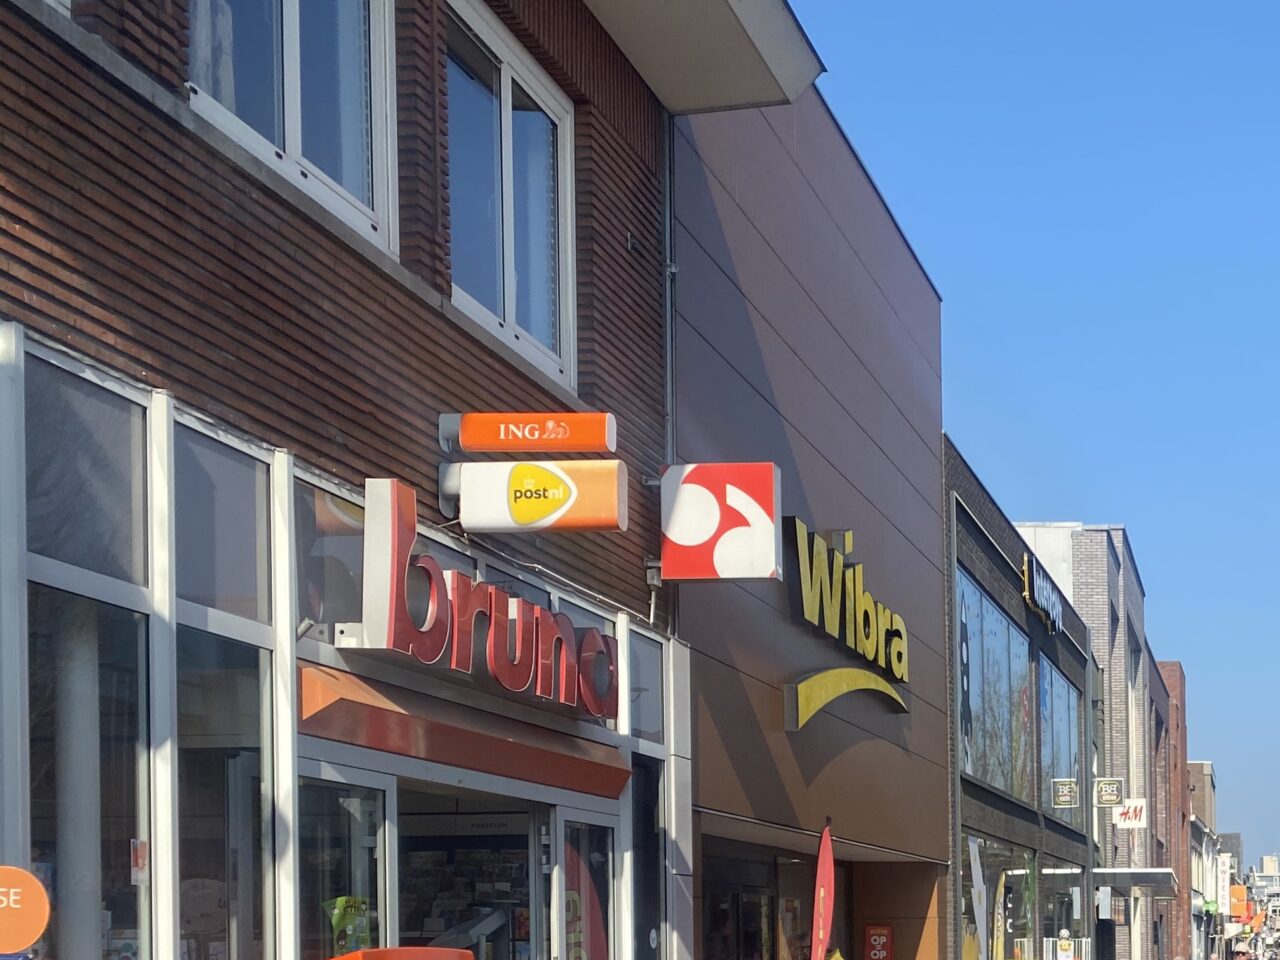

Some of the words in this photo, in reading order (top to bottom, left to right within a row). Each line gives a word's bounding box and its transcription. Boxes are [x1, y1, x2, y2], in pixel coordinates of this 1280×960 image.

[498, 423, 540, 440] ING
[513, 484, 564, 504] postnl
[363, 477, 619, 719] bruna
[795, 516, 910, 683] Wibra
[870, 935, 887, 946] OP
[870, 950, 887, 960] OP
